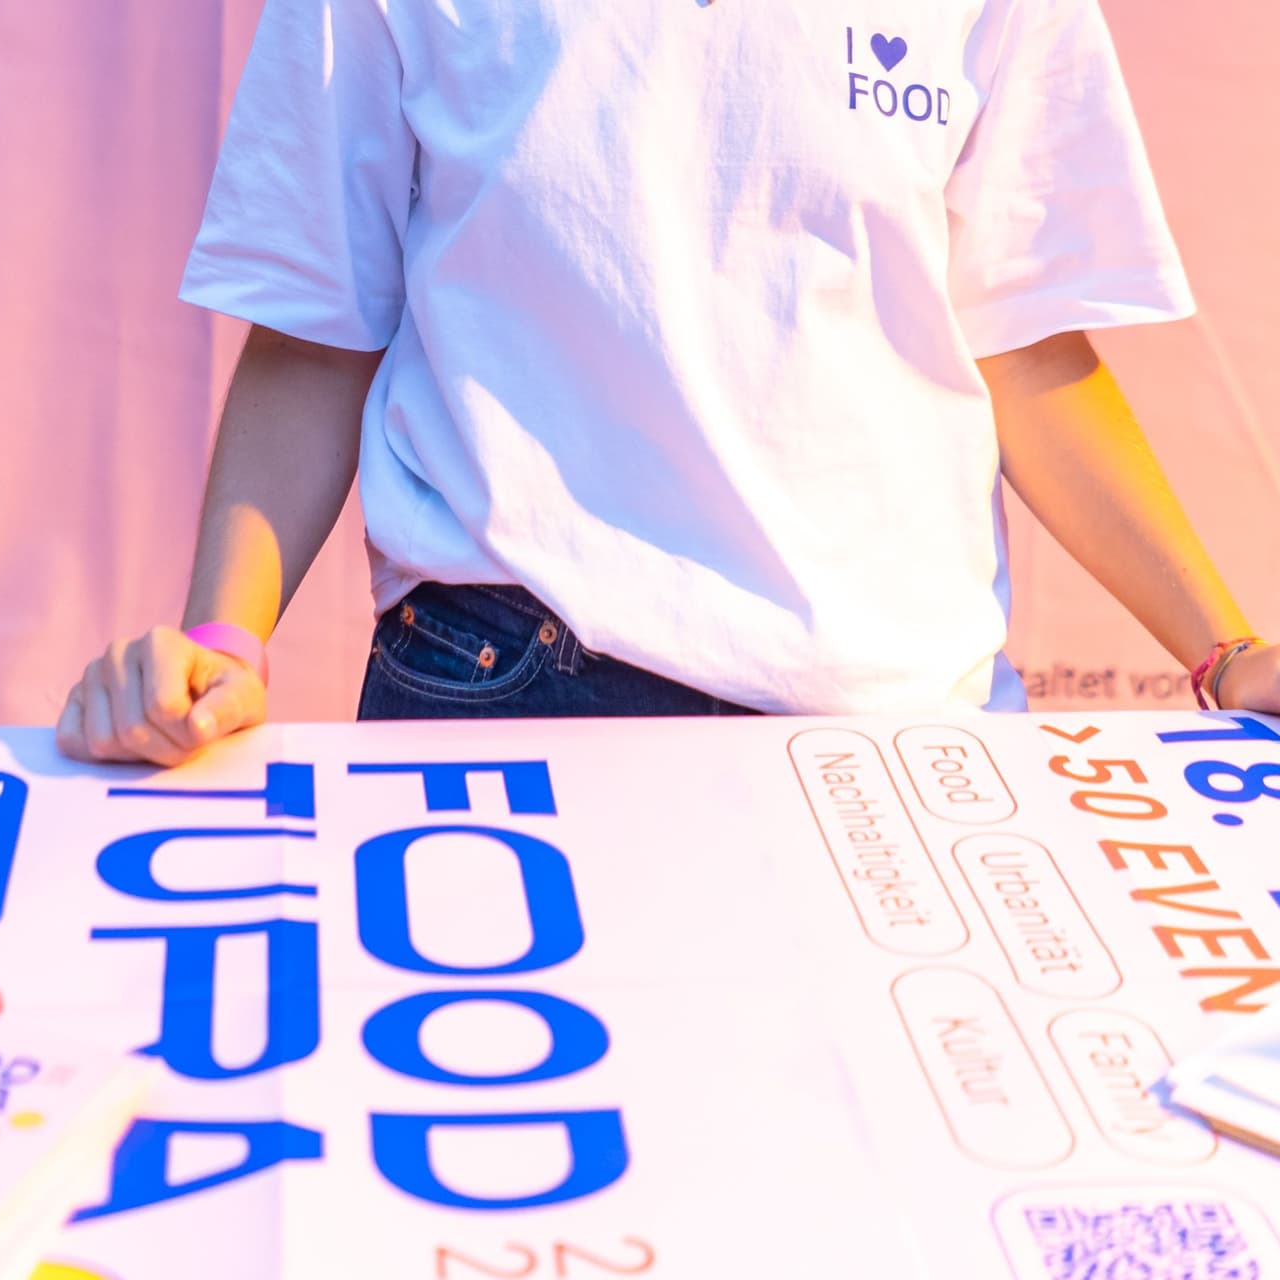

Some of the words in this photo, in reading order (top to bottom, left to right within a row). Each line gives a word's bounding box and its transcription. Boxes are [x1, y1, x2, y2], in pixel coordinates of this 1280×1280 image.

[846, 26, 853, 65] I
[848, 72, 951, 126] FOOD
[921, 743, 995, 805] Food
[812, 751, 932, 929] Nachhaltigkeit
[979, 851, 1083, 977] Urbanität
[64, 762, 325, 1228] TURA
[347, 760, 631, 1211] FOOD
[931, 1015, 1011, 1110] Kultur
